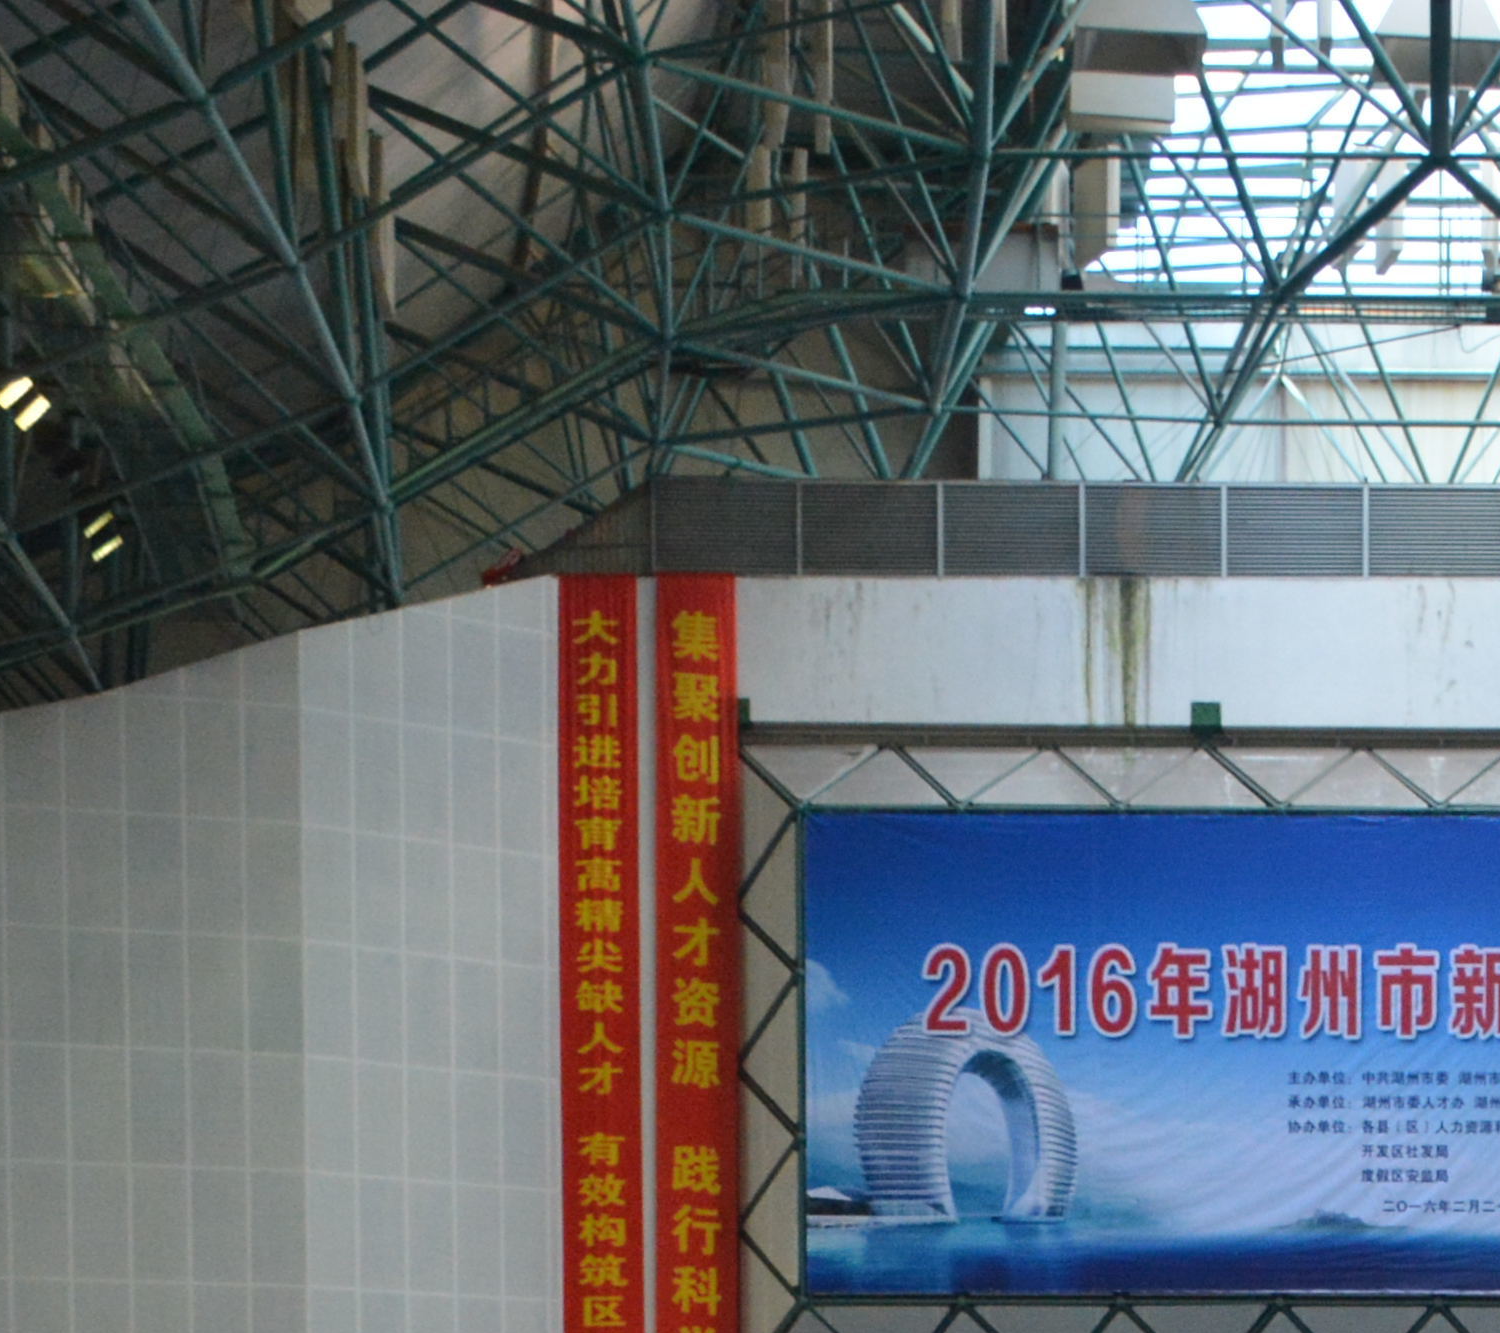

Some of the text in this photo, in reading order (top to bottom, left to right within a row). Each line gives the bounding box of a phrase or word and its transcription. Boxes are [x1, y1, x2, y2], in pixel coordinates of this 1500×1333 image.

[573, 608, 625, 1096] 大力引进培育高精尖缺人才
[670, 609, 721, 1090] 集聚创新人才资源
